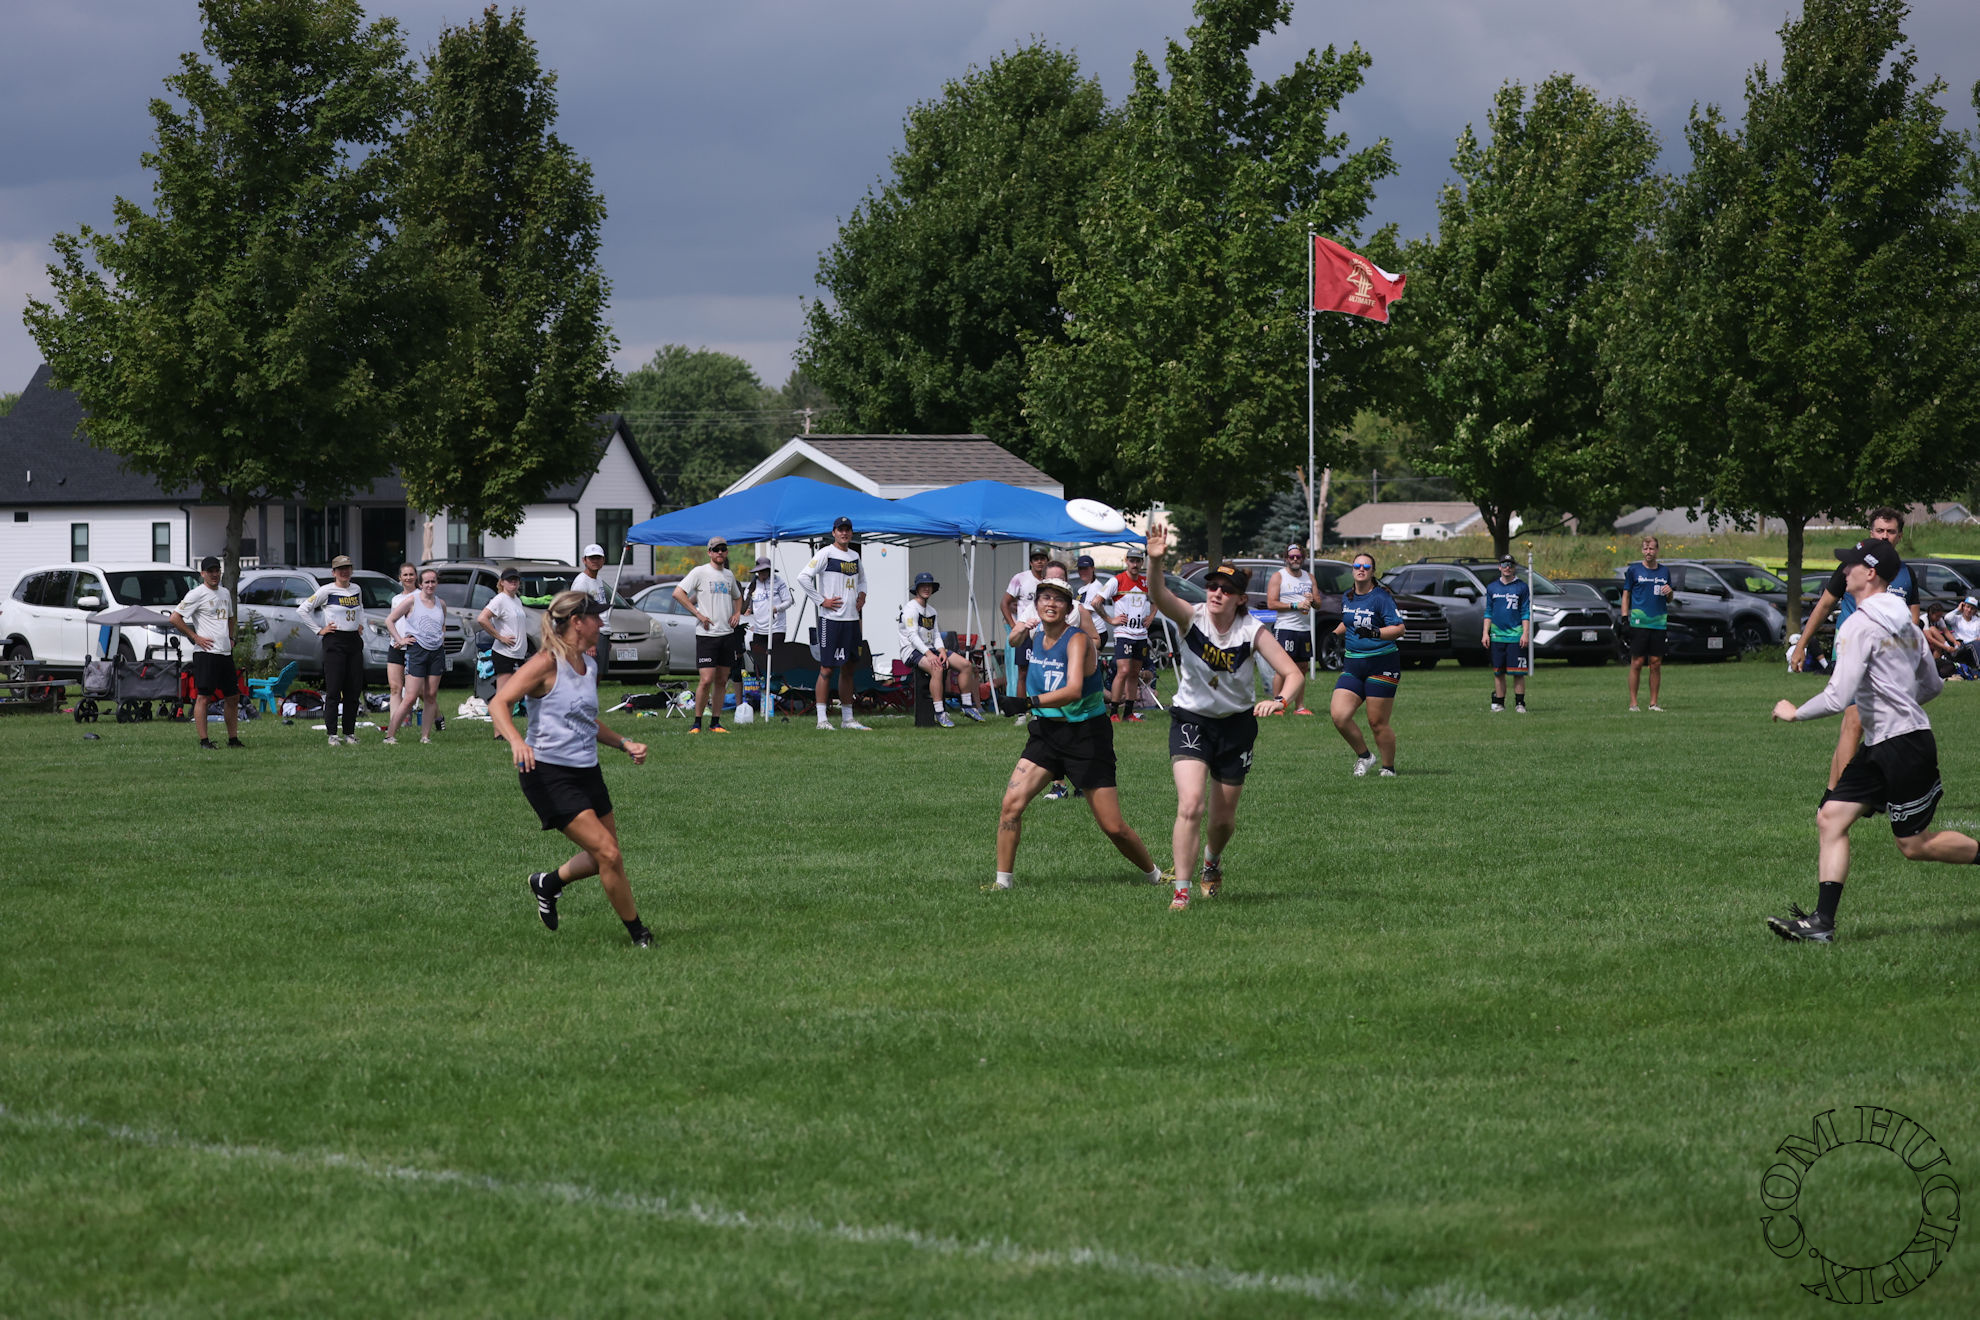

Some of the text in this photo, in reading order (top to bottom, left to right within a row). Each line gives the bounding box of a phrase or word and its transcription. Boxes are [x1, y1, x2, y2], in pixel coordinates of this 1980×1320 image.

[1349, 295, 1376, 306] ULTIMATE
[338, 596, 359, 606] NOISE
[345, 609, 356, 622] 33
[1284, 640, 1294, 652] 88
[833, 647, 845, 660] 44
[1201, 643, 1236, 673] NOISE
[1517, 657, 1527, 668] 72
[1044, 670, 1065, 692] 17
